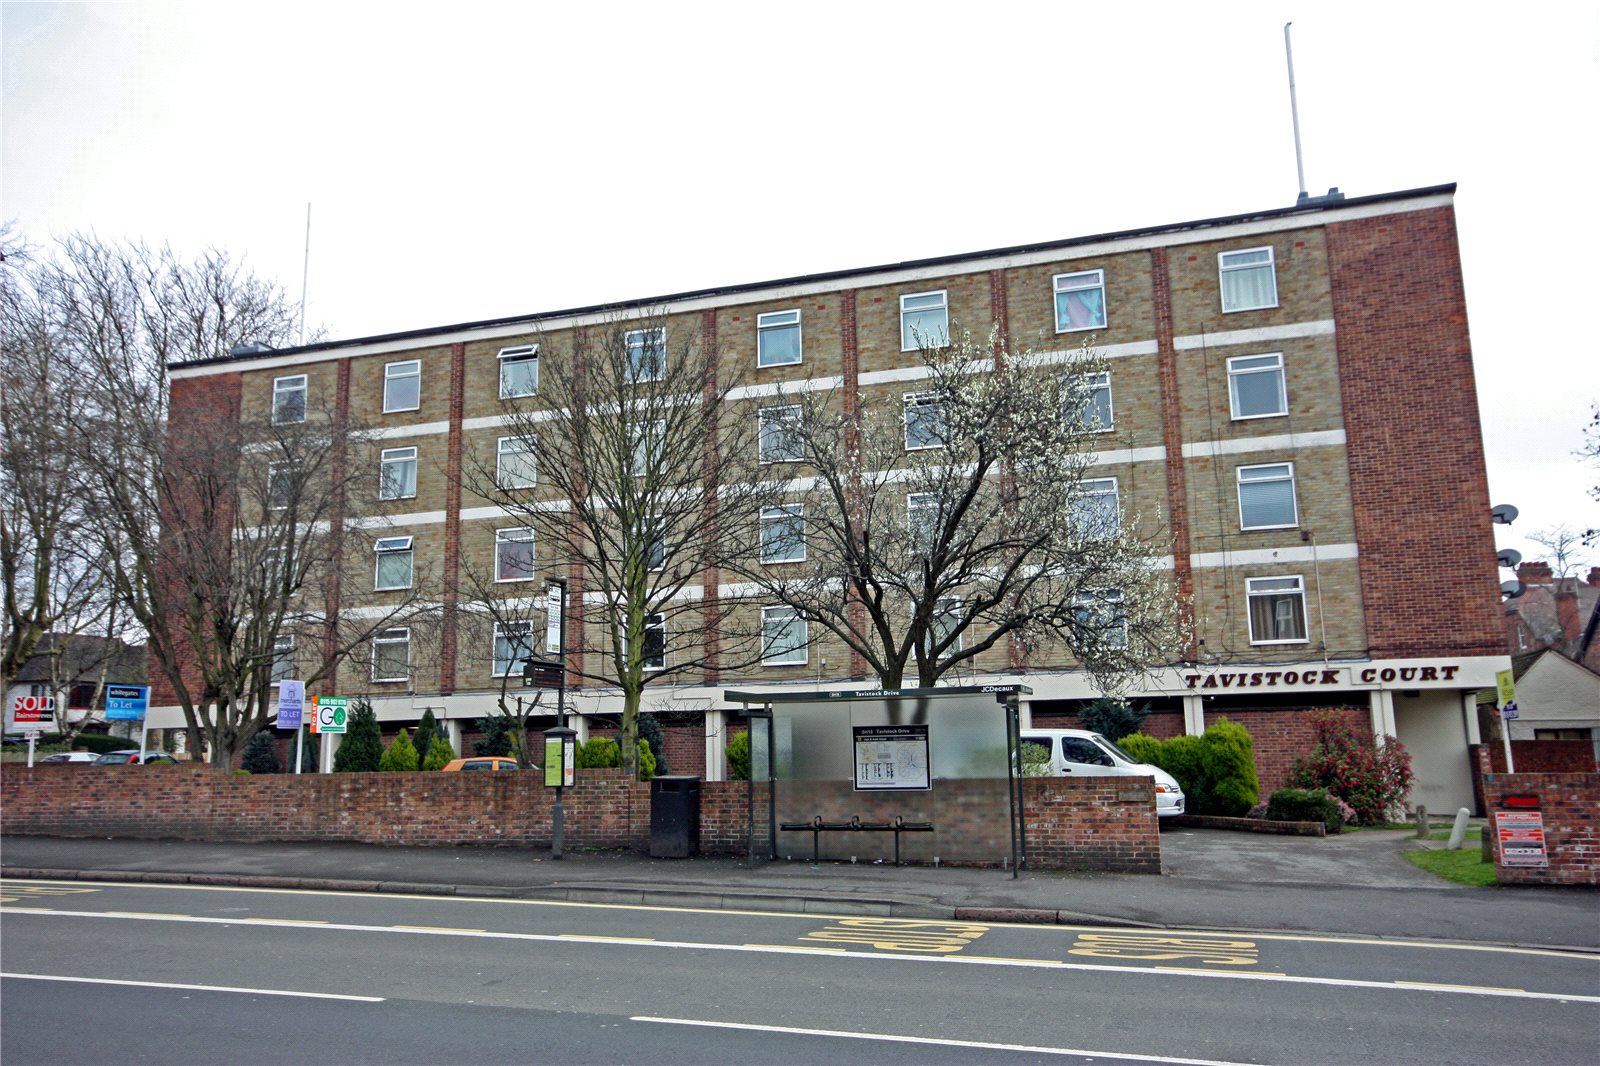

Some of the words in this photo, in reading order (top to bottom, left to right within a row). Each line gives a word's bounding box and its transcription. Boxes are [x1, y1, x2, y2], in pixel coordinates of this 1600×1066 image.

[1185, 670, 1340, 688] TAVISTOCK
[1361, 666, 1459, 683] COURT
[14, 696, 55, 711] SOLD
[109, 700, 118, 708] To
[120, 701, 133, 709] Let
[280, 710, 289, 718] TO
[290, 711, 300, 719] LET
[798, 919, 990, 952] STOP
[1067, 933, 1259, 965] BUS
